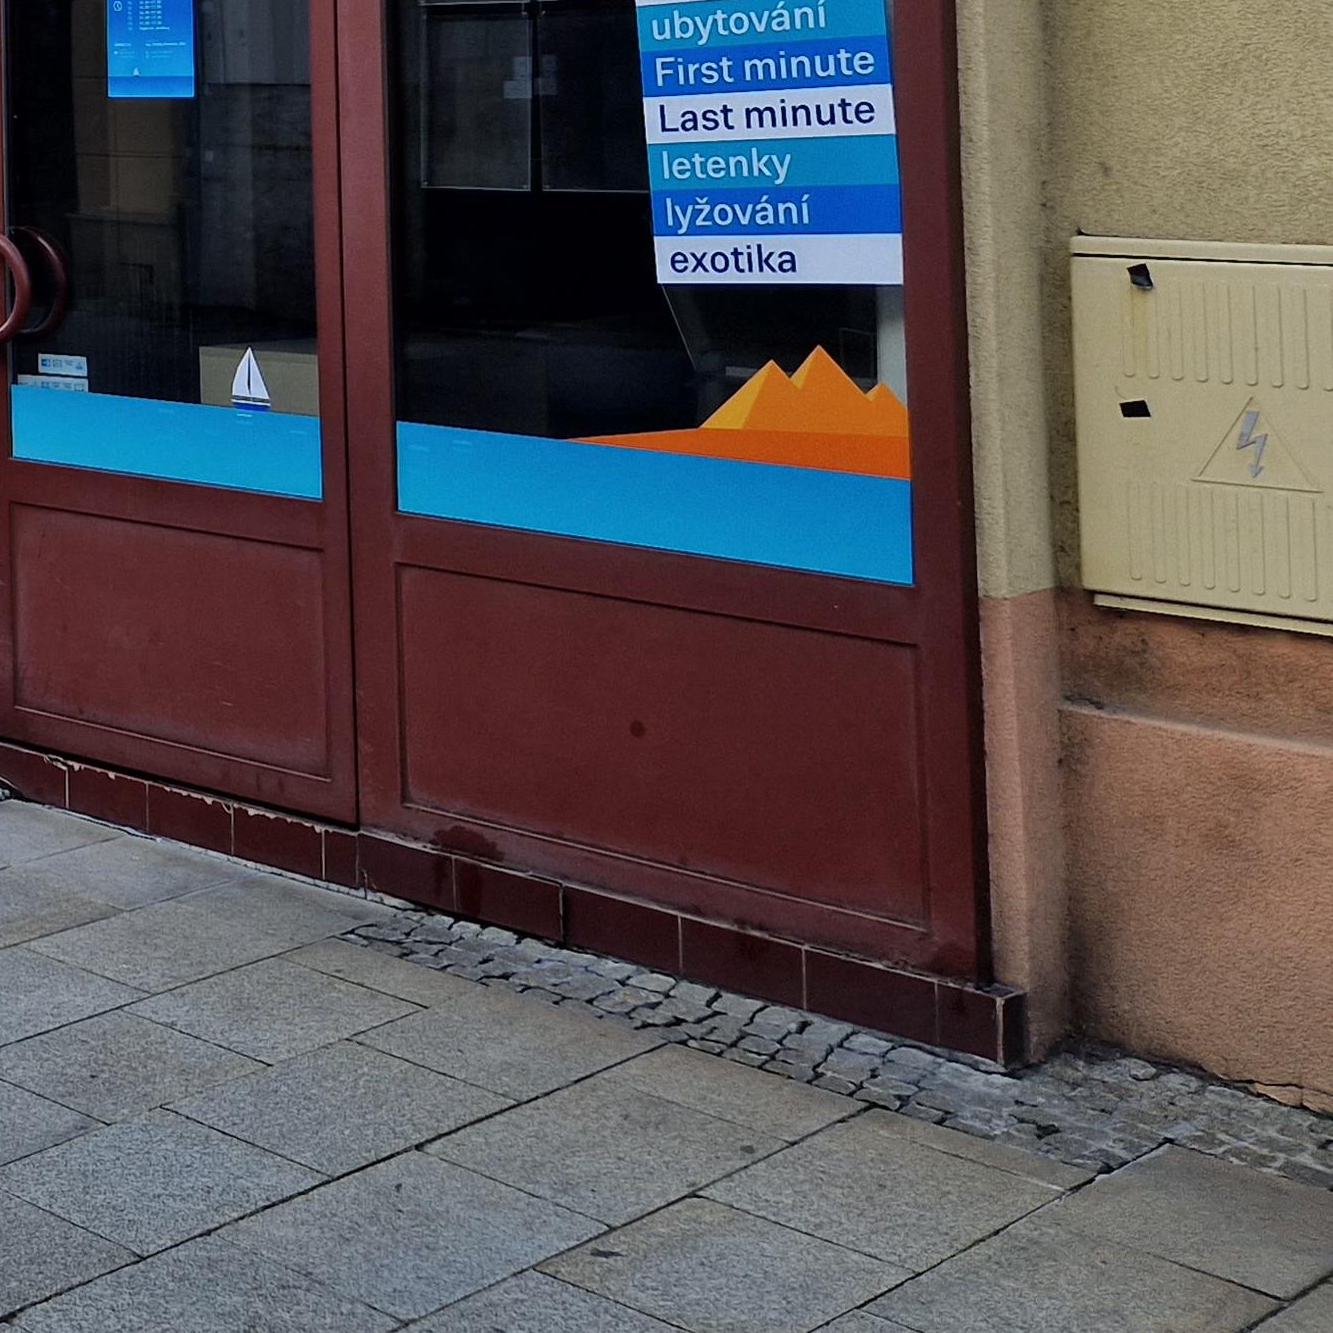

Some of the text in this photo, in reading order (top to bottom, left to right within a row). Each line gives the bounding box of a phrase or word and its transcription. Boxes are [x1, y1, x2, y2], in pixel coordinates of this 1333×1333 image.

[655, 48, 876, 88] First minute
[658, 96, 876, 134] Last minute
[661, 148, 792, 185] letenky
[665, 193, 811, 234] lyžování
[669, 244, 798, 275] exotika
